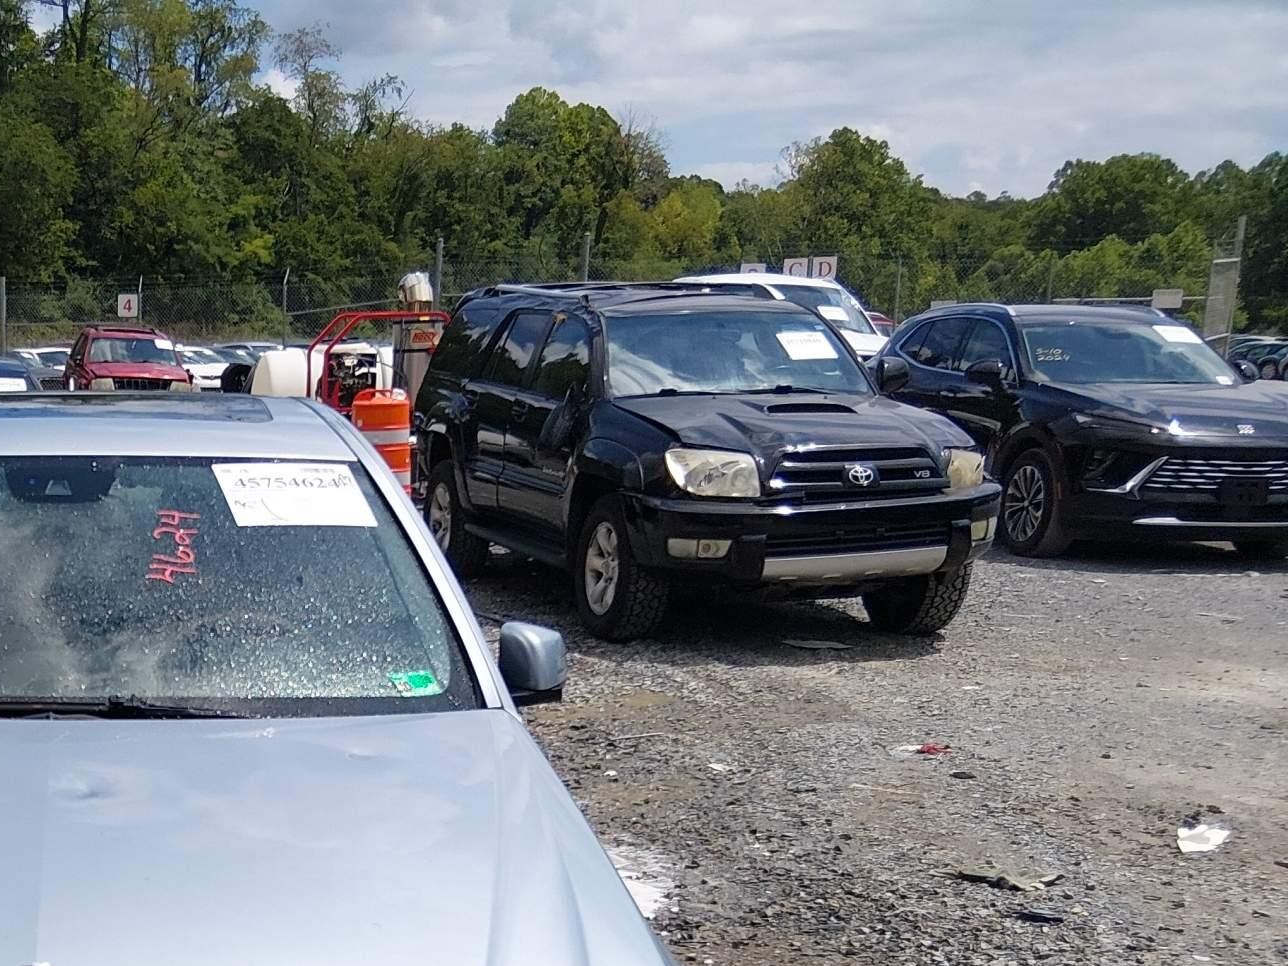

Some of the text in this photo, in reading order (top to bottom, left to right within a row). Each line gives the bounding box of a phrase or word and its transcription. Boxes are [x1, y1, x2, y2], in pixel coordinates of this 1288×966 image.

[789, 262, 802, 276] C
[818, 261, 832, 277] D
[123, 299, 132, 313] 4
[914, 470, 930, 478] V8
[145, 508, 201, 584] 4624
